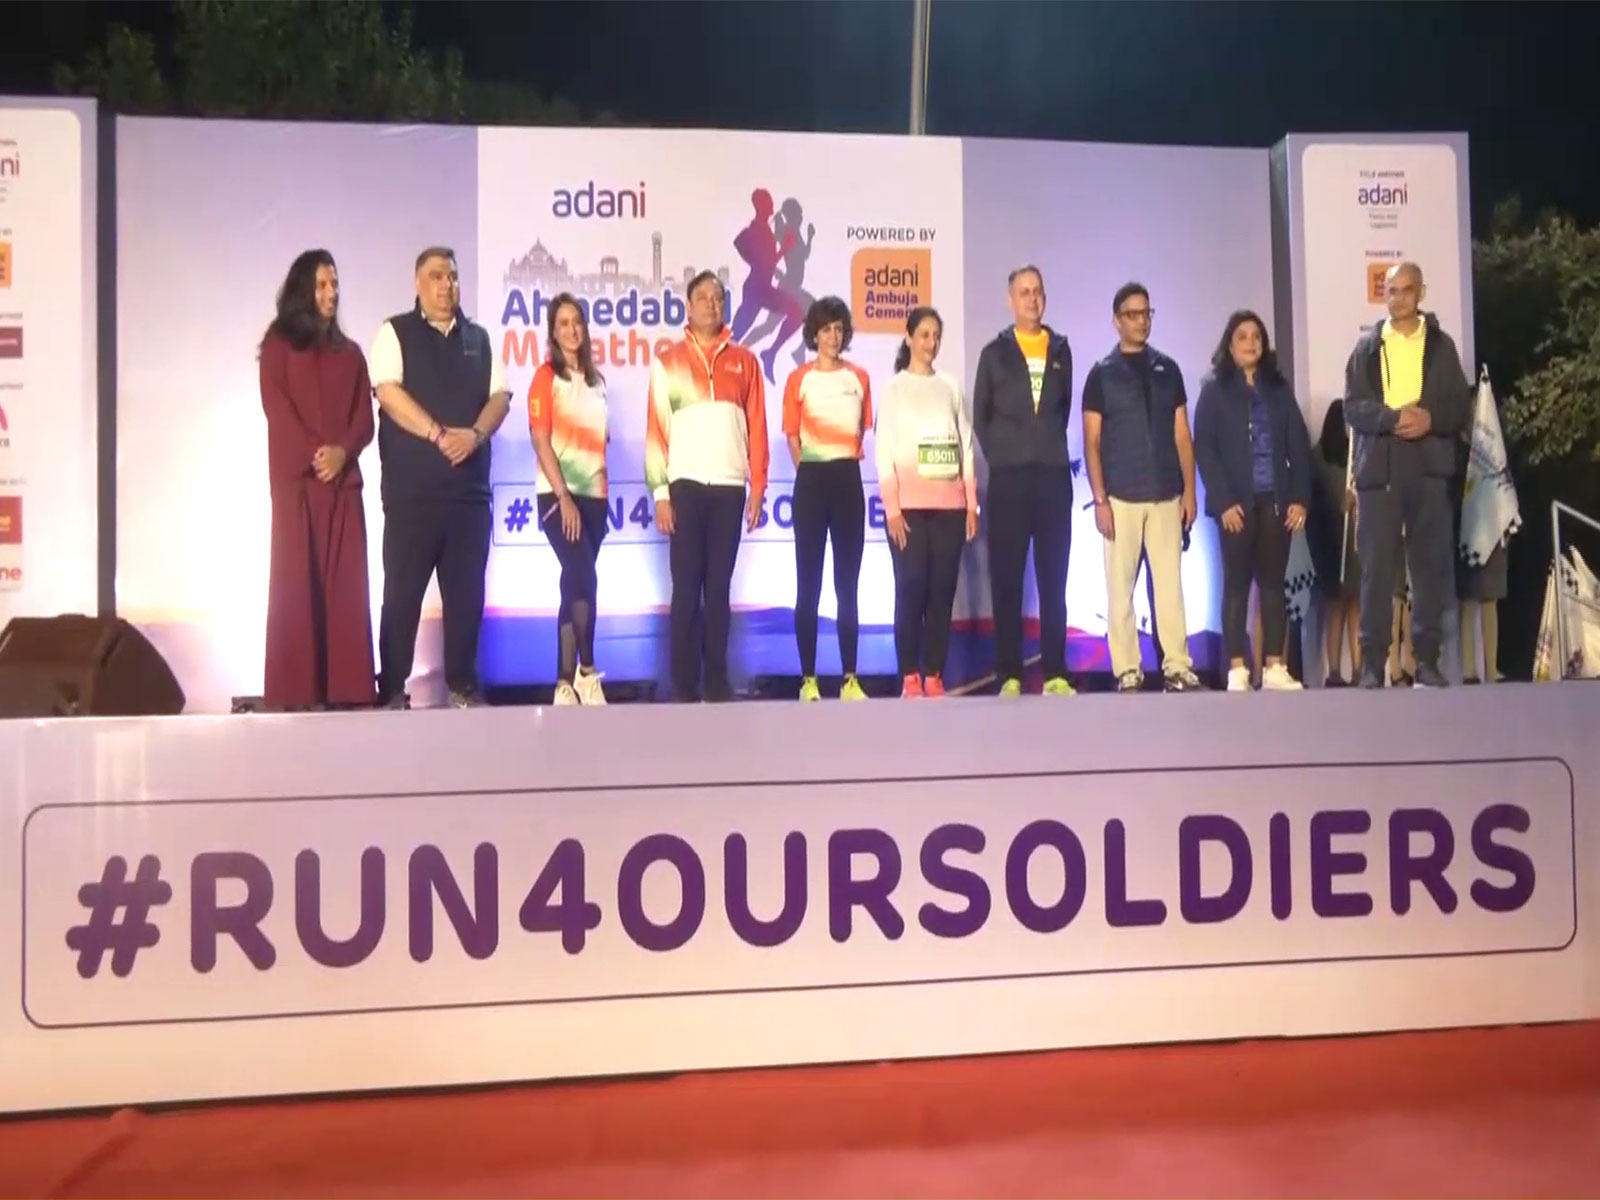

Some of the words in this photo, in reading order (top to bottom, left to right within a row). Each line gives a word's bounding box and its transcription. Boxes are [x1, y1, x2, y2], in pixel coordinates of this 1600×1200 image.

[552, 180, 646, 218] adani
[1357, 182, 1408, 206] adani
[847, 226, 915, 241] POWERED
[919, 227, 936, 241] BY
[864, 263, 919, 287] adani
[501, 288, 731, 326] Ahedab
[866, 290, 918, 306] Ambuja
[66, 803, 1536, 977] #RUN4OURSOLDIERS
